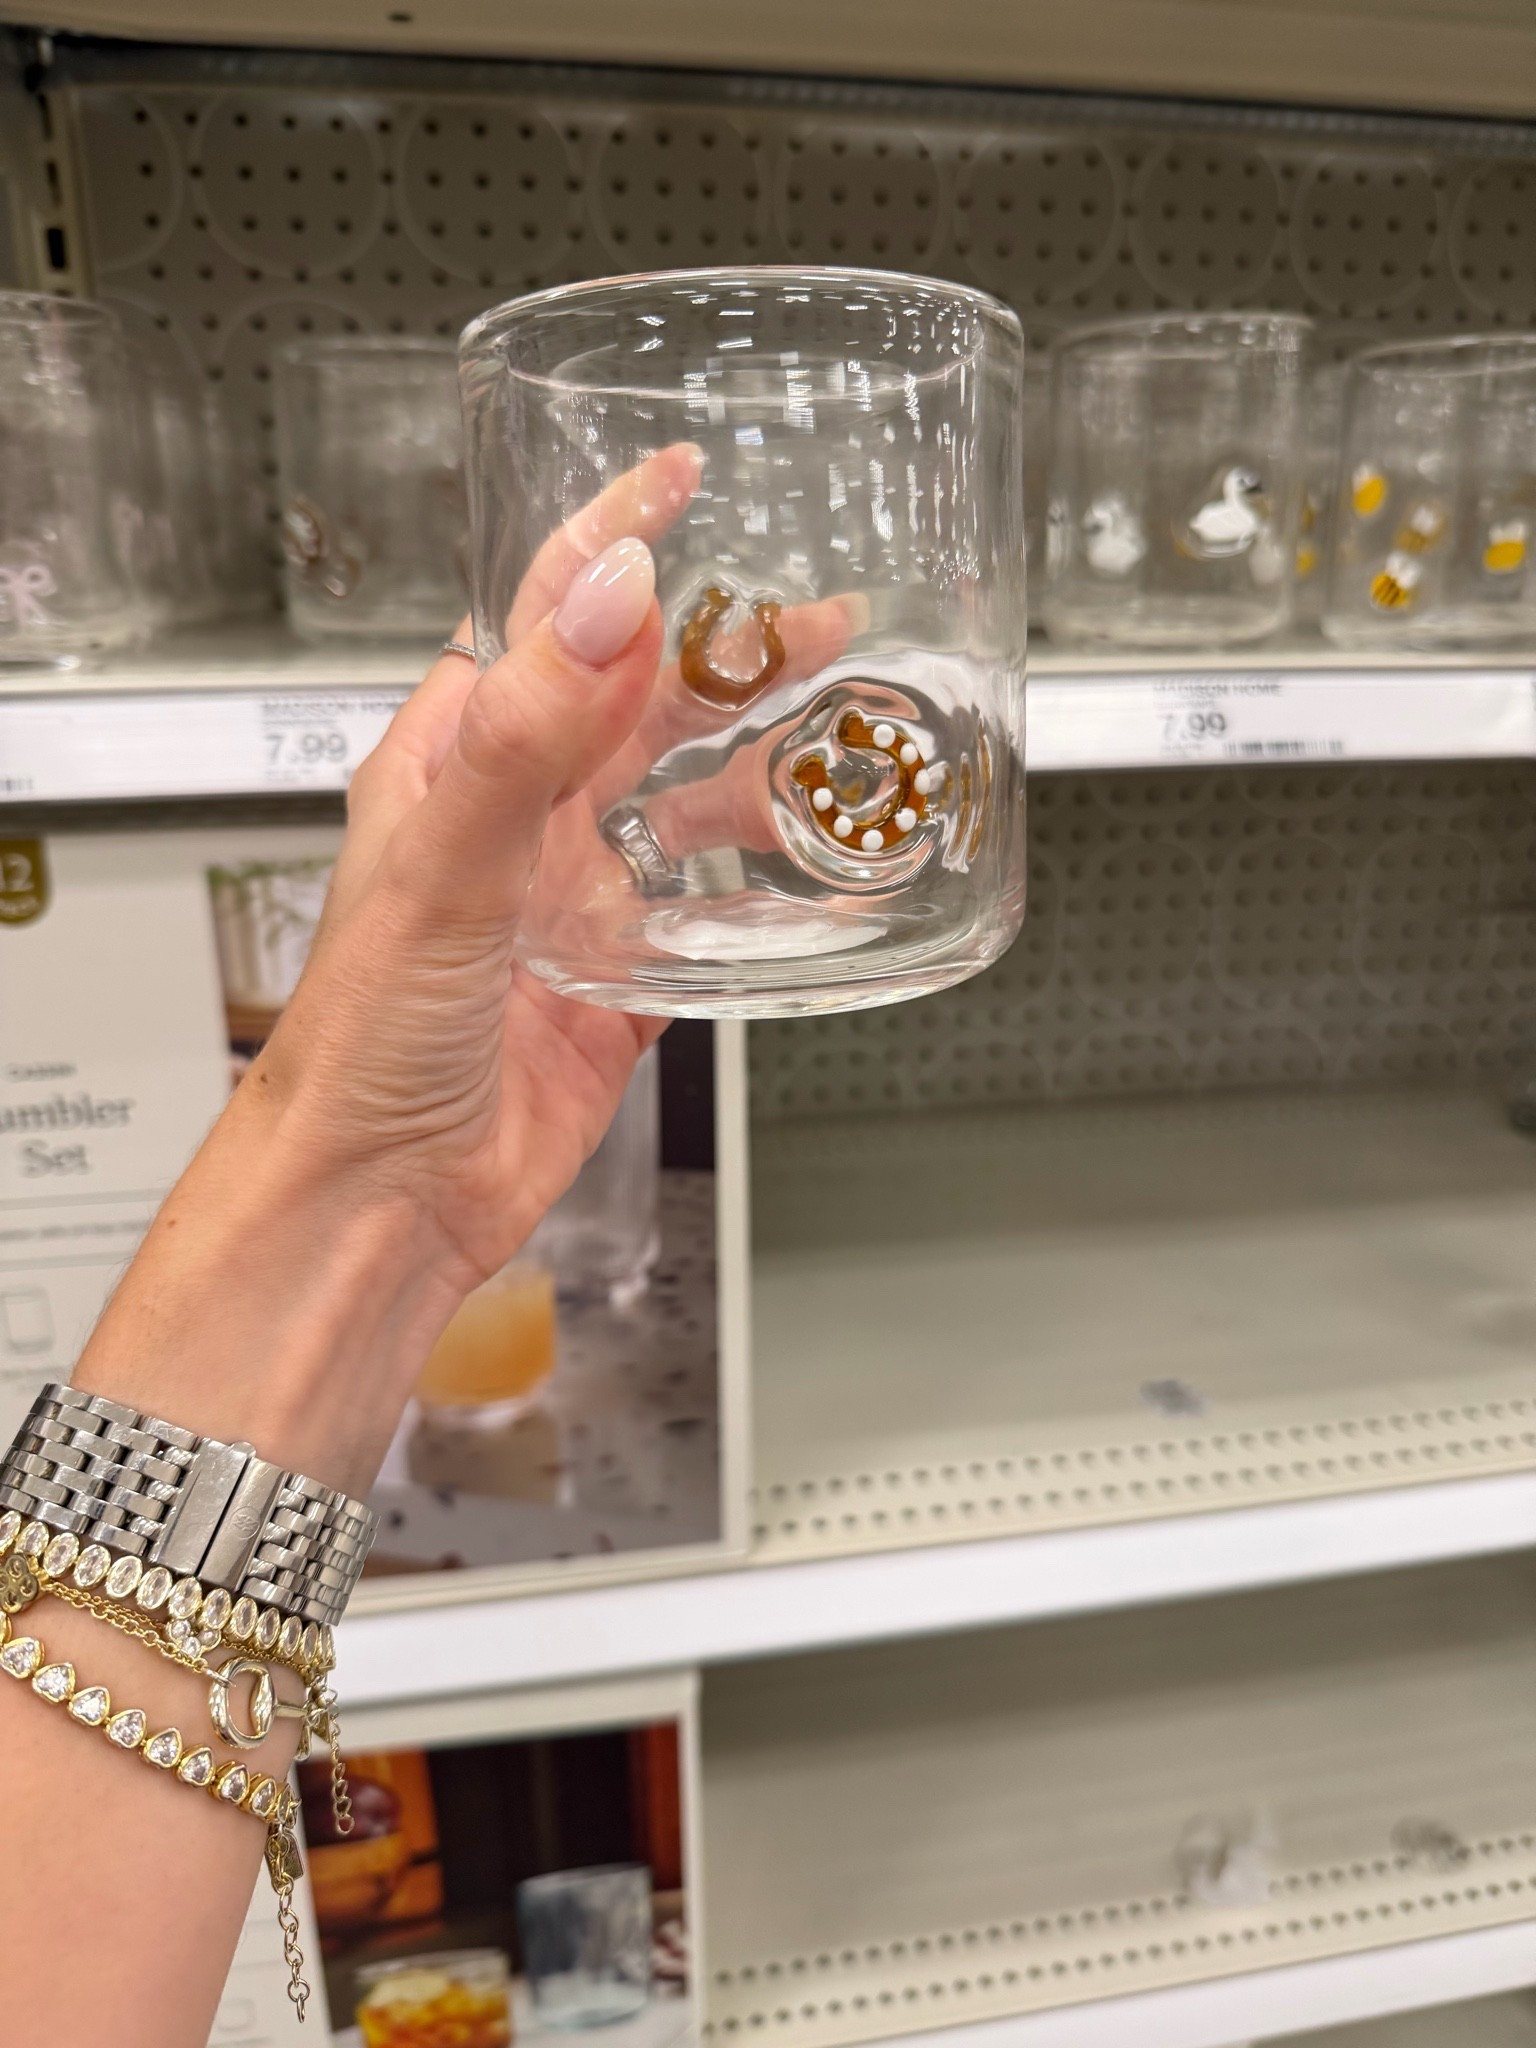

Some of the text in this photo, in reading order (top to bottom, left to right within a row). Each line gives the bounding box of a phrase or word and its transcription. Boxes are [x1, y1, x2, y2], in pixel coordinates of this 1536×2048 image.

[1157, 712, 1227, 741] 7.99
[264, 732, 348, 765] 7.99
[20, 1138, 91, 1179] Set
